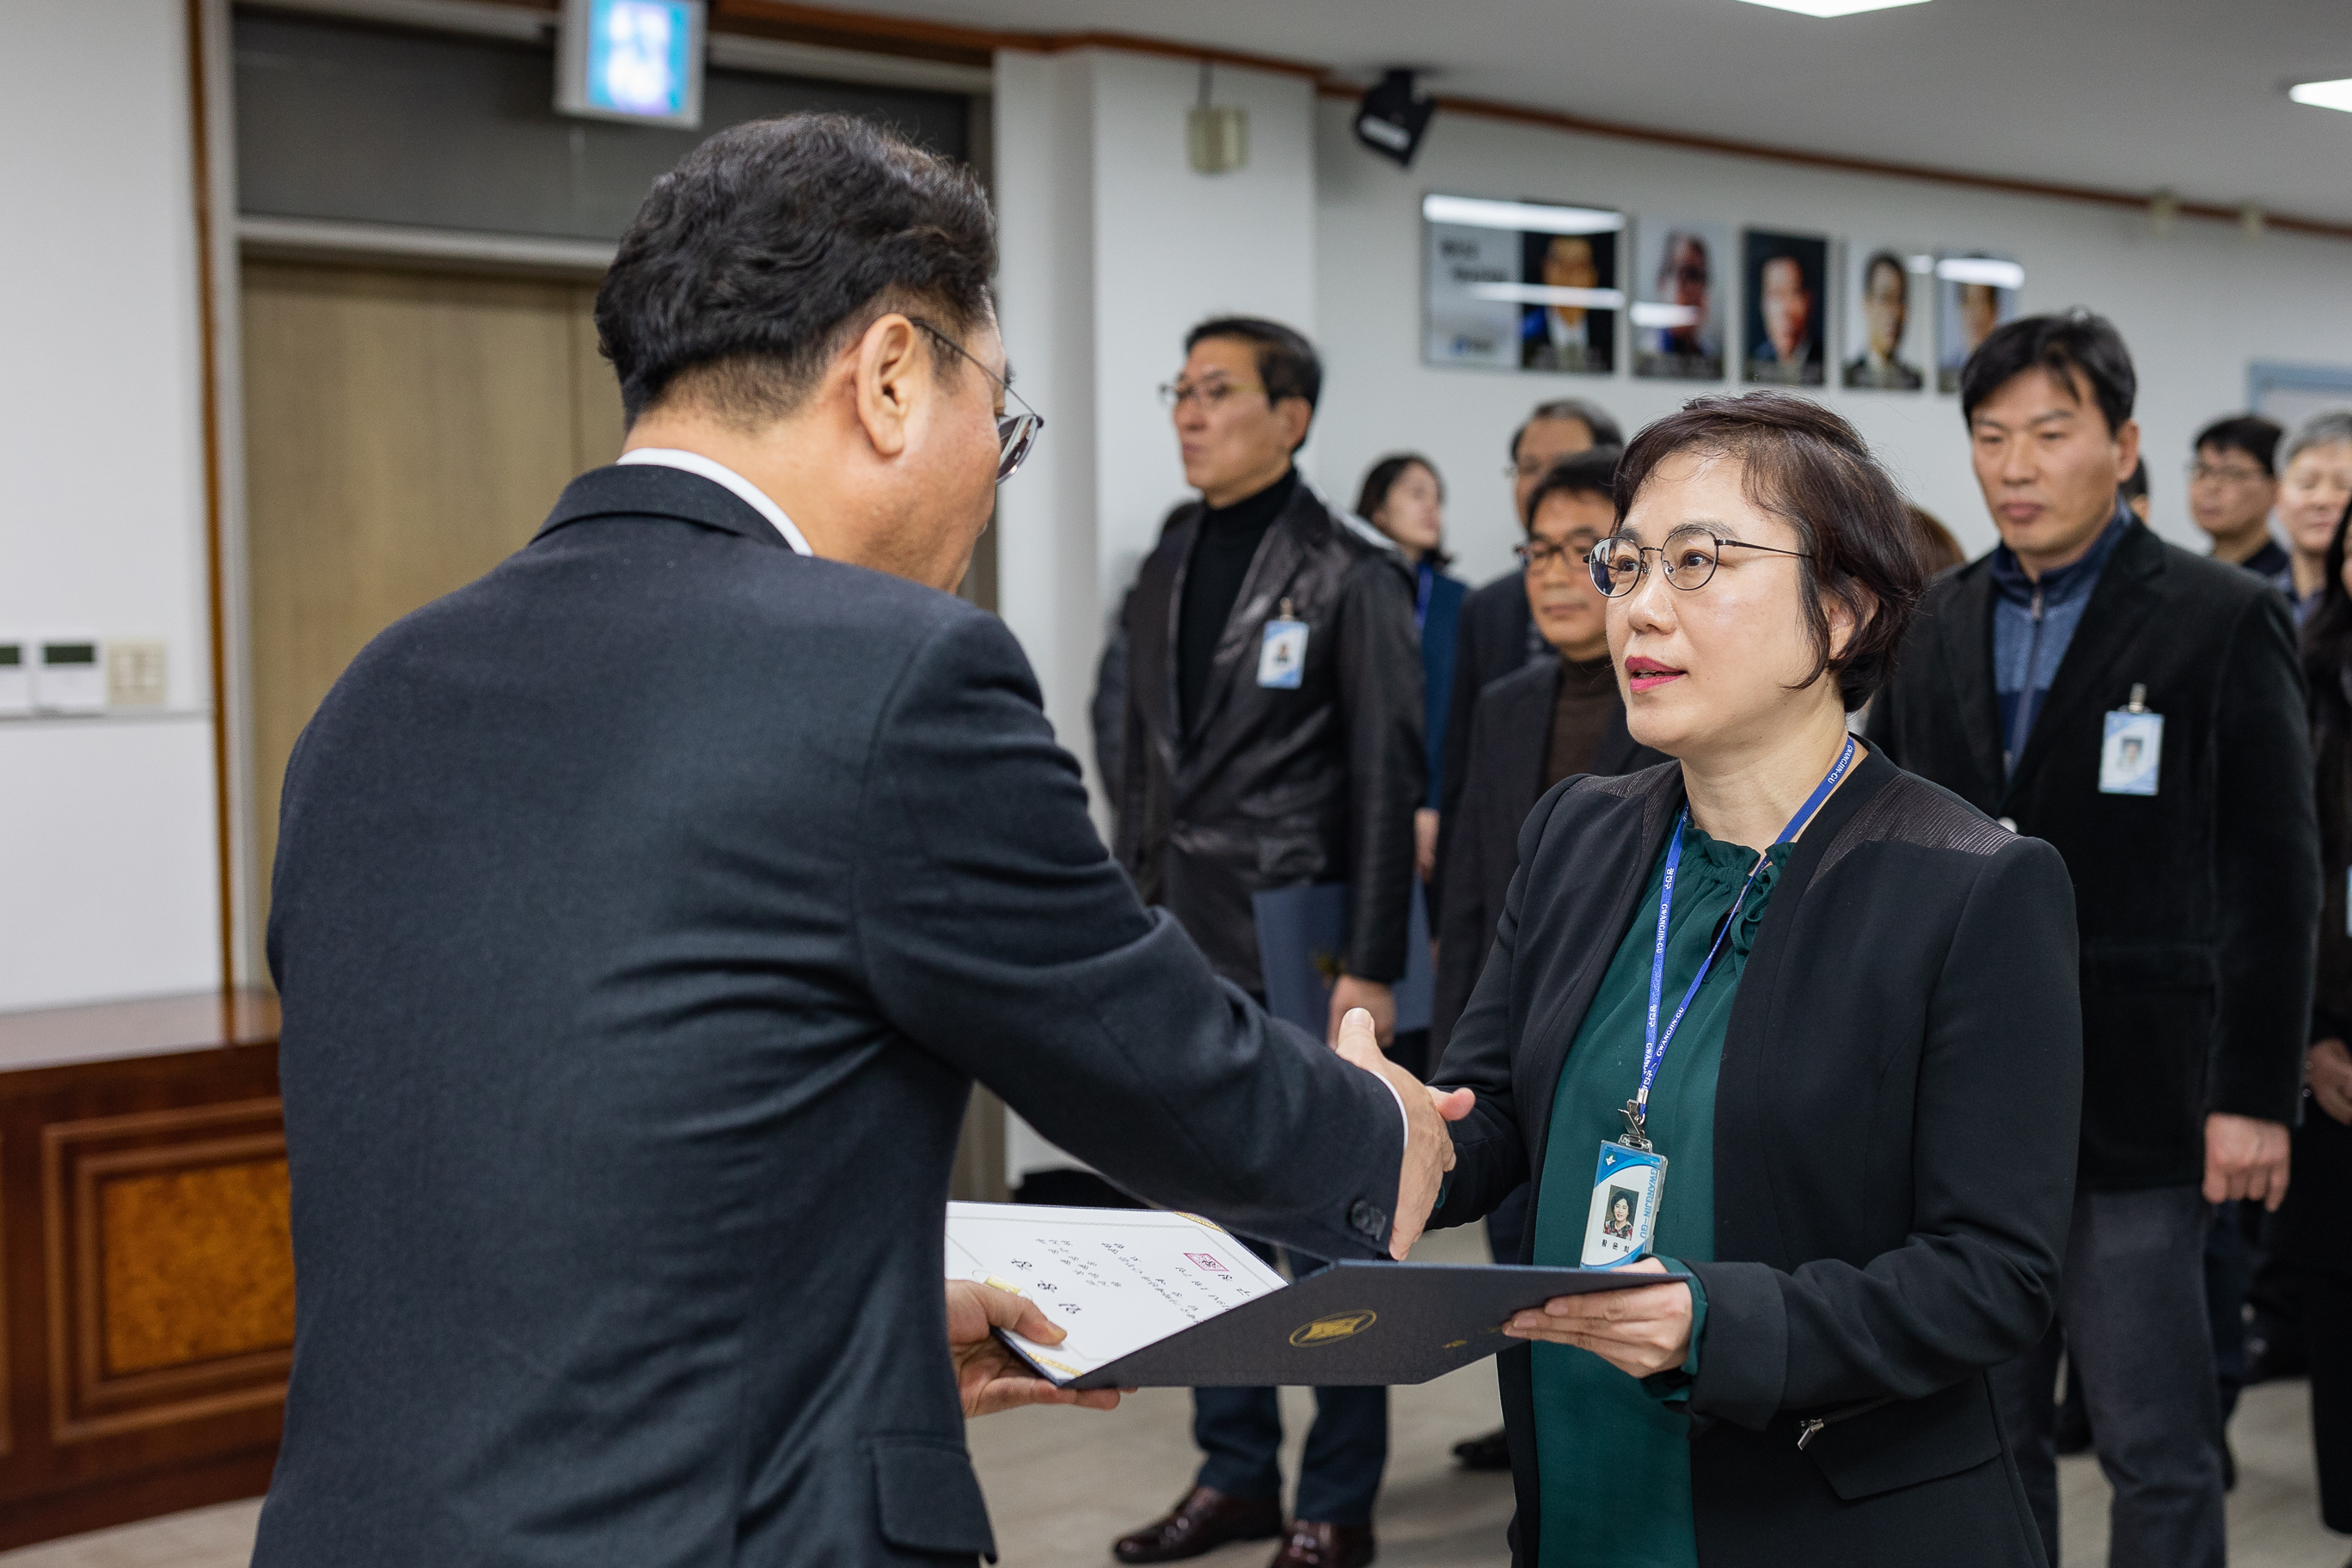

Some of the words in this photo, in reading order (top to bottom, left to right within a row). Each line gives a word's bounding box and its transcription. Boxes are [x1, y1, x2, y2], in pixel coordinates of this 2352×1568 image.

[1664, 867, 1675, 890] 광진구
[1656, 903, 1669, 954] GWANGJIN-GU
[1646, 1004, 1657, 1027] 광진구
[1656, 1008, 1685, 1057] GWANGJIN-GU
[1639, 1167, 1658, 1239] GWANGJIN-GU
